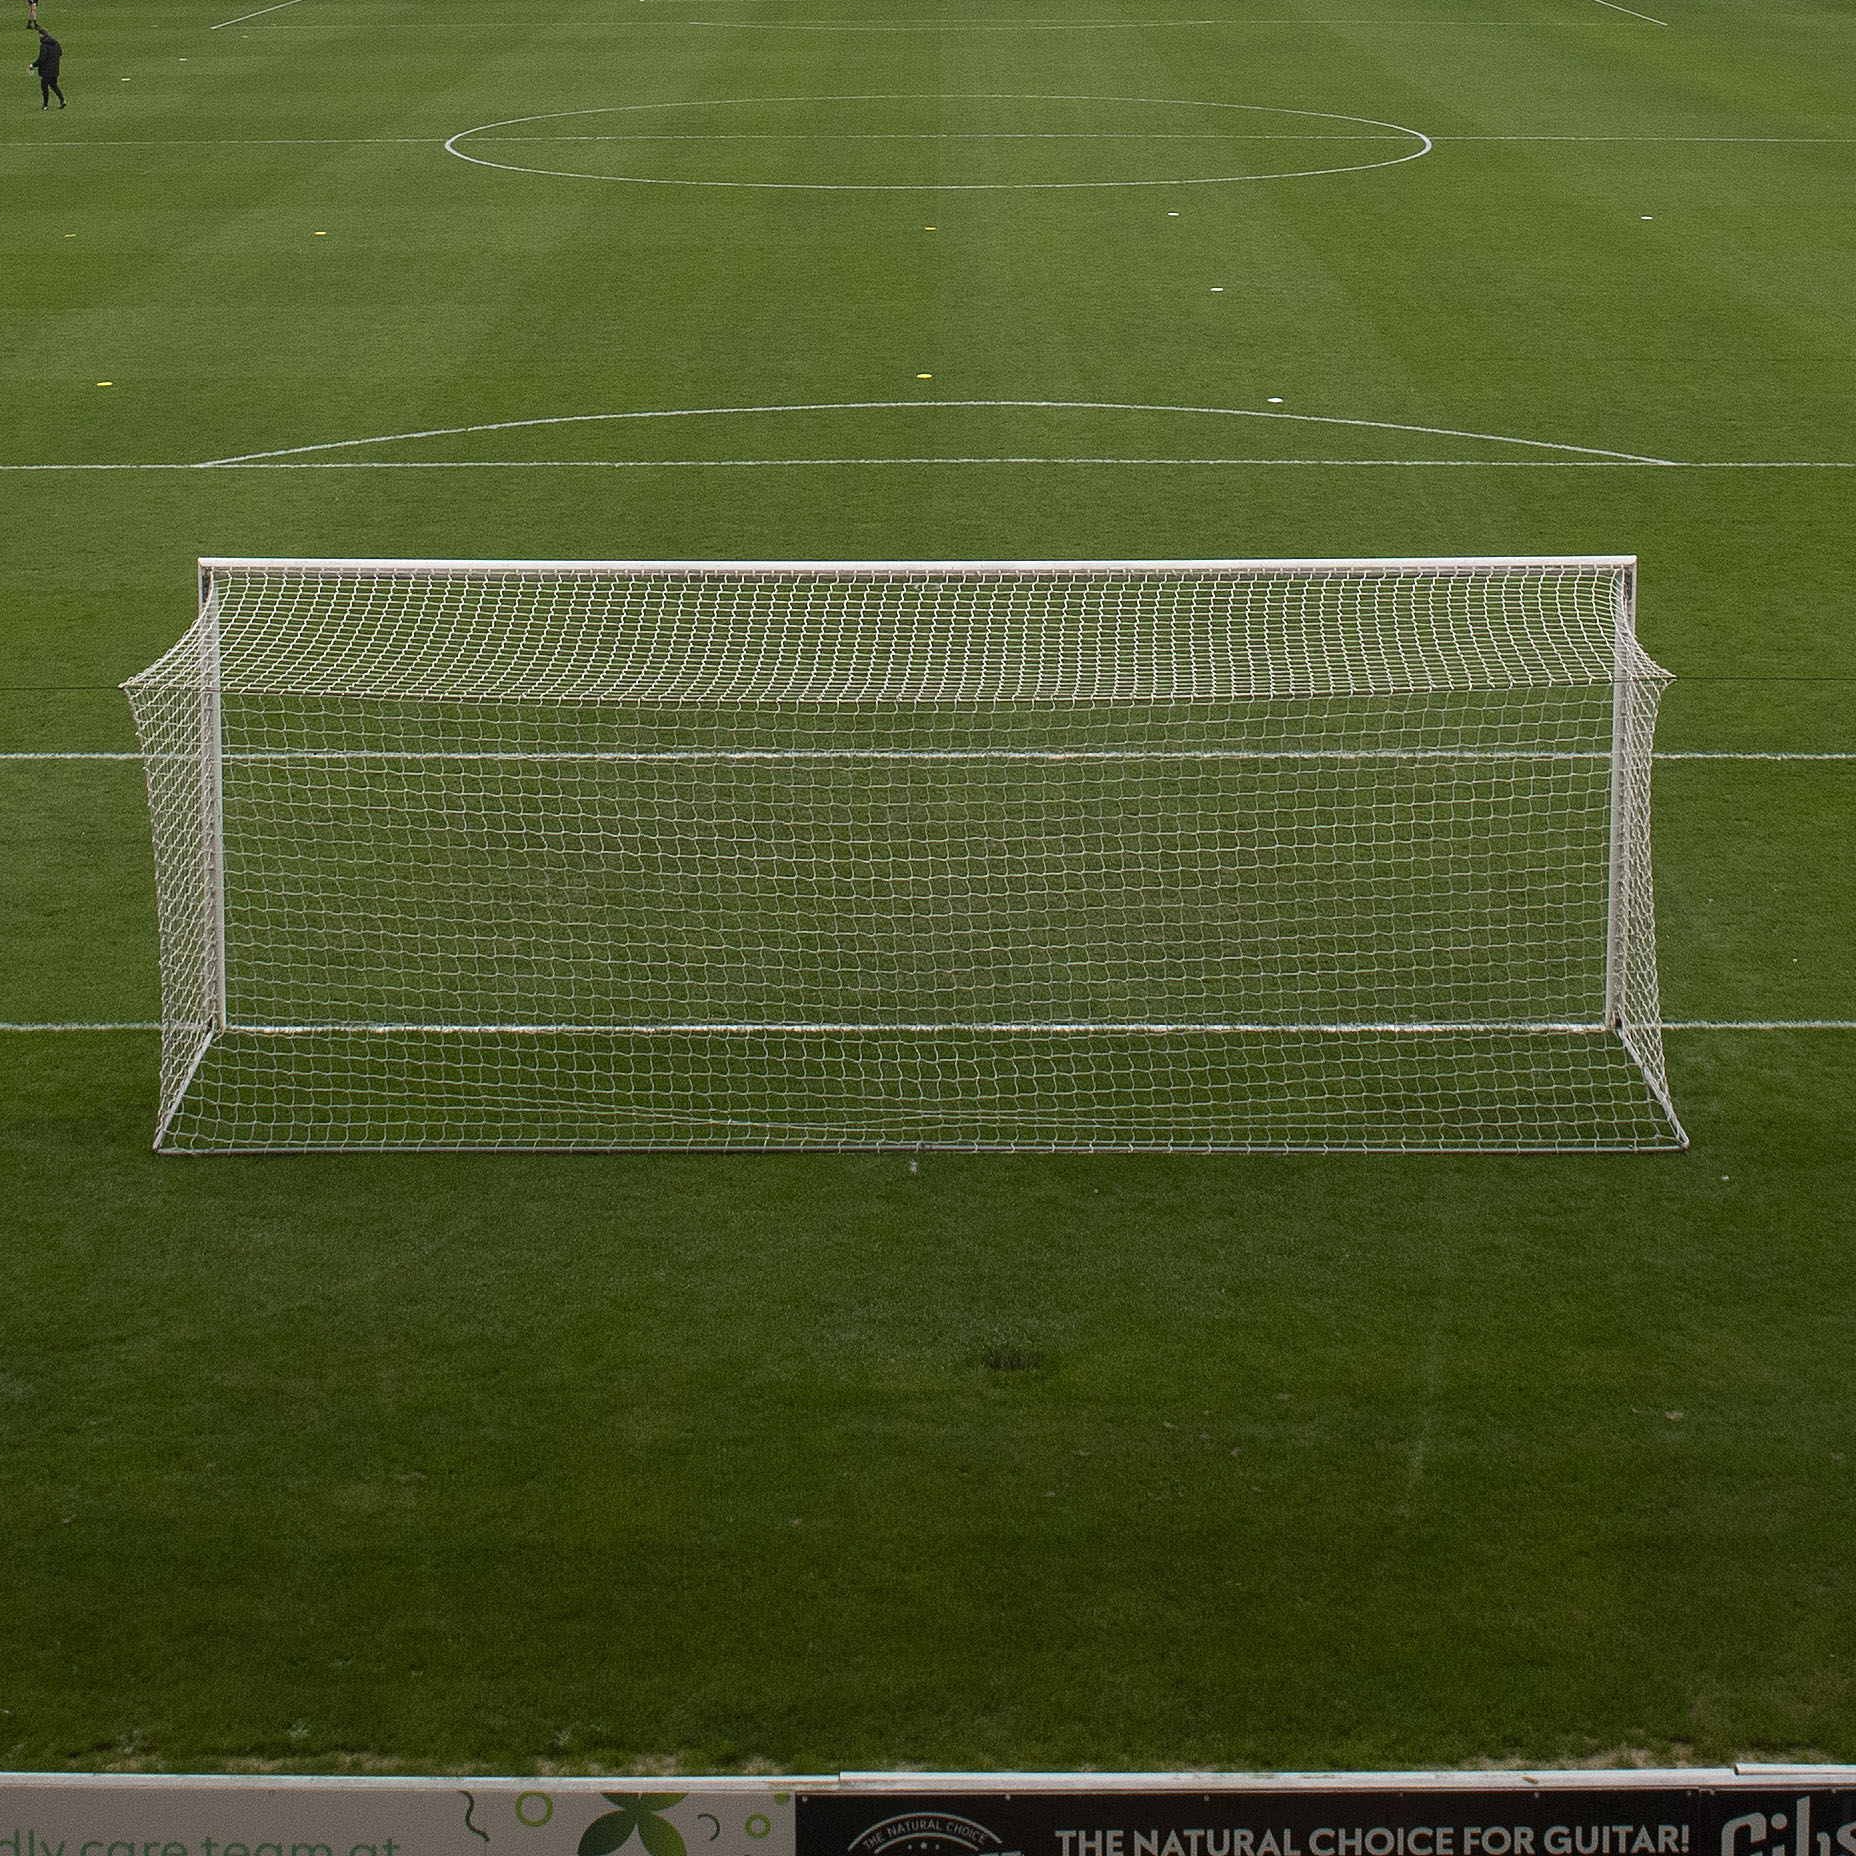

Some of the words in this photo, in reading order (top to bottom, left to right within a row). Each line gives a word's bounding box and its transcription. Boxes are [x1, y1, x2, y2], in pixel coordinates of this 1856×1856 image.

[861, 1831, 886, 1849] THE
[887, 1818, 944, 1837] NATURAL
[945, 1820, 987, 1845] CHOICE
[1055, 1828, 1125, 1856] THE
[1133, 1827, 1302, 1856] NATURAL
[1308, 1826, 1454, 1856] CHOICE
[1463, 1825, 1536, 1856] FOR
[1544, 1824, 1690, 1856] GUITAR!
